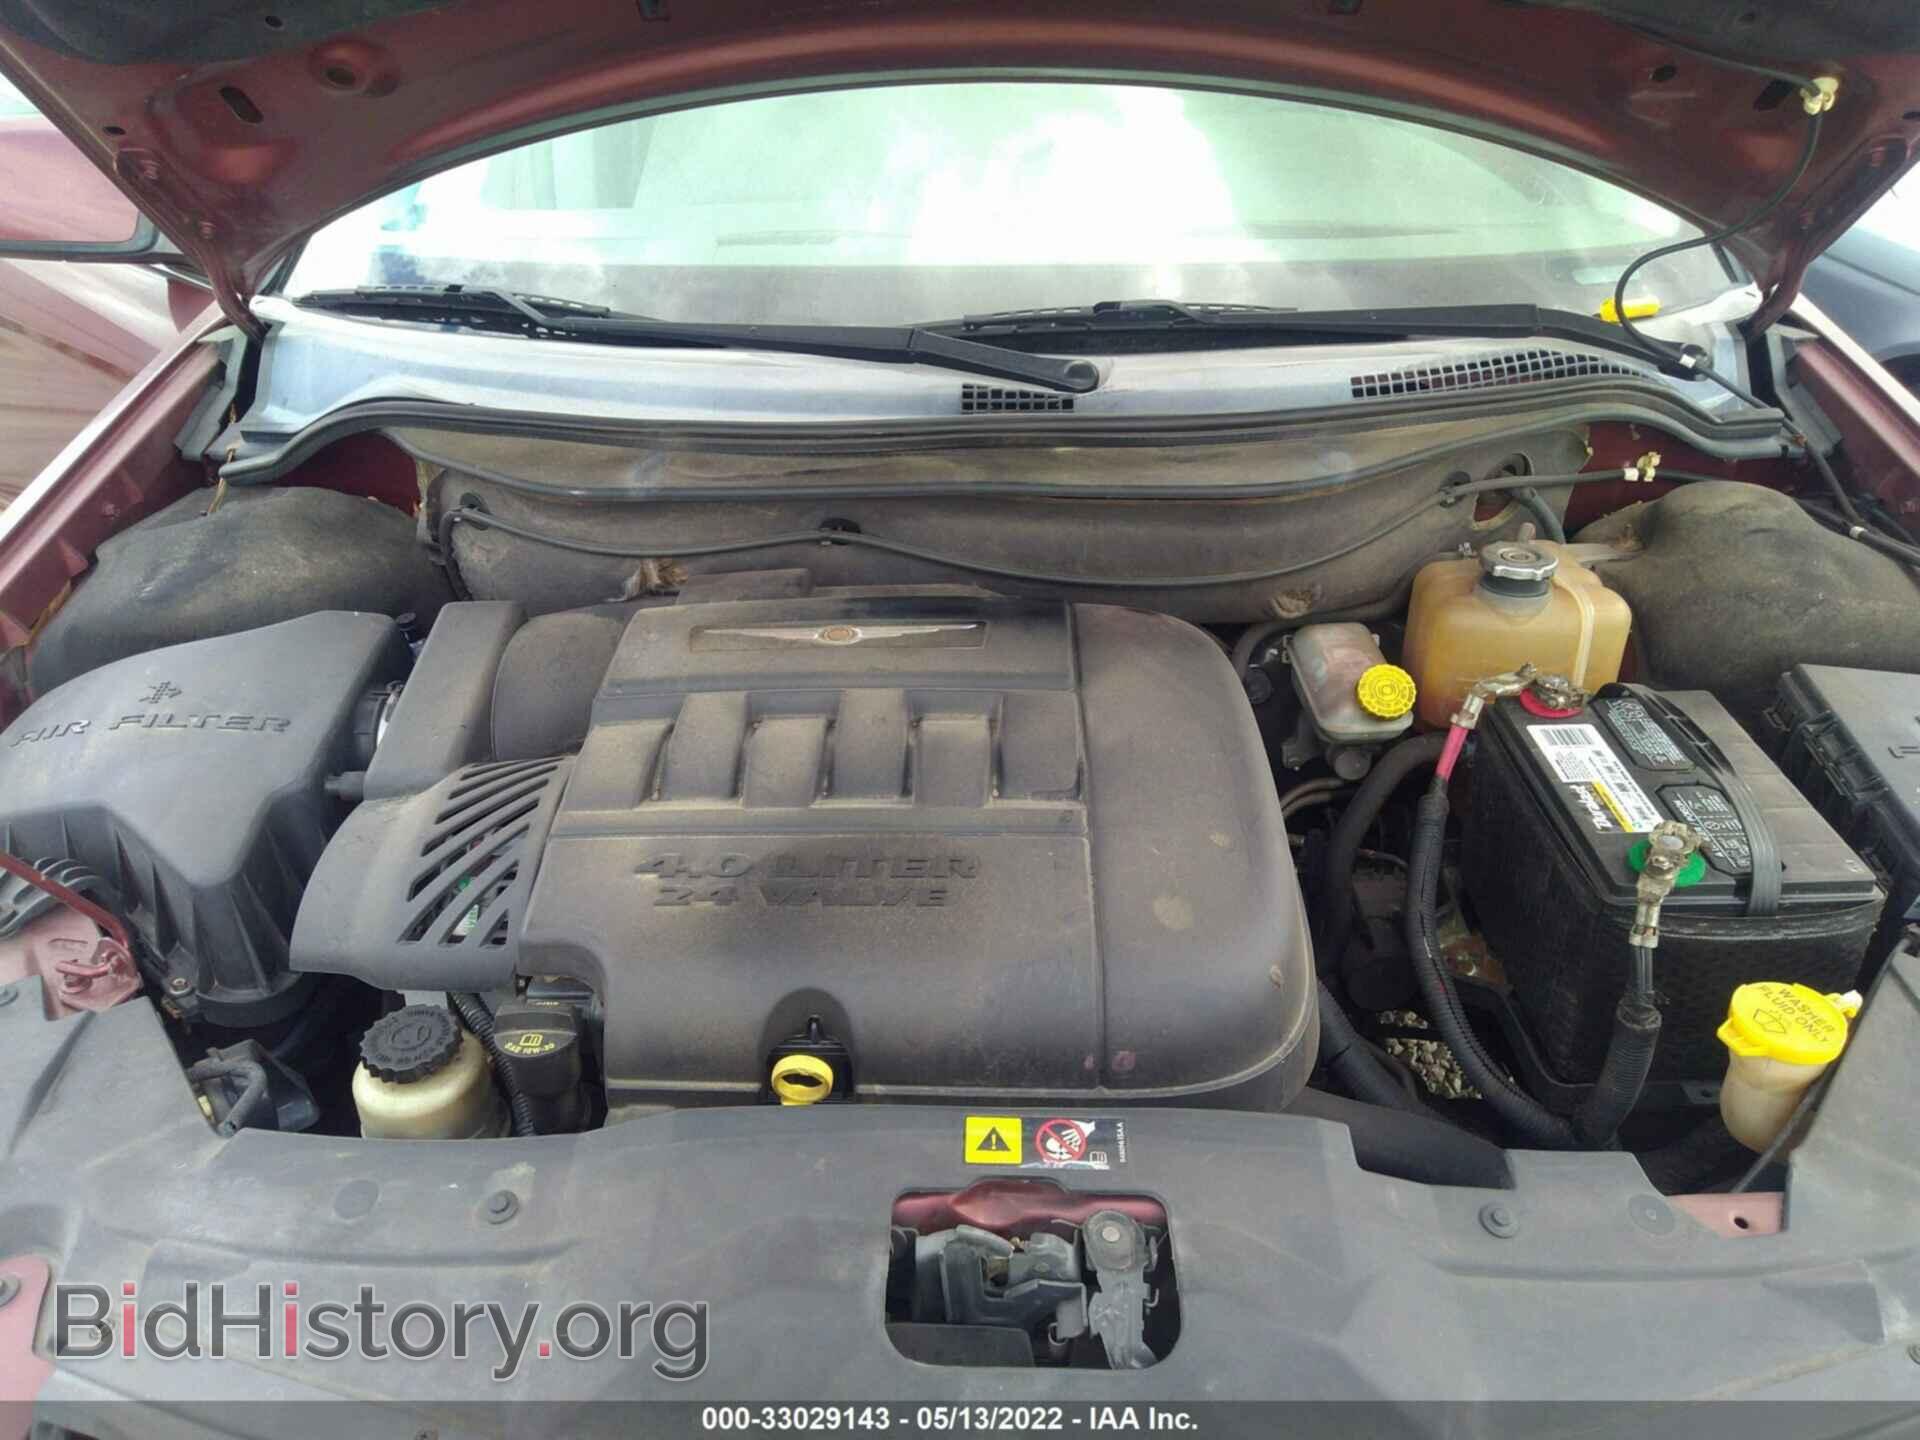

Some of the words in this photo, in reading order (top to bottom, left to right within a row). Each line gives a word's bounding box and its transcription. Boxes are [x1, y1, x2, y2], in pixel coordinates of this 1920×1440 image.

[9, 720, 91, 748] AIR
[107, 713, 292, 733] FILTER
[634, 852, 752, 879] 4.0
[764, 852, 979, 879] LITER
[652, 885, 742, 907] 24
[757, 882, 951, 907] VALVE
[1760, 985, 1796, 1015] FLUID
[1795, 1016, 1828, 1042] ONLY
[1779, 988, 1835, 1033] WASHER
